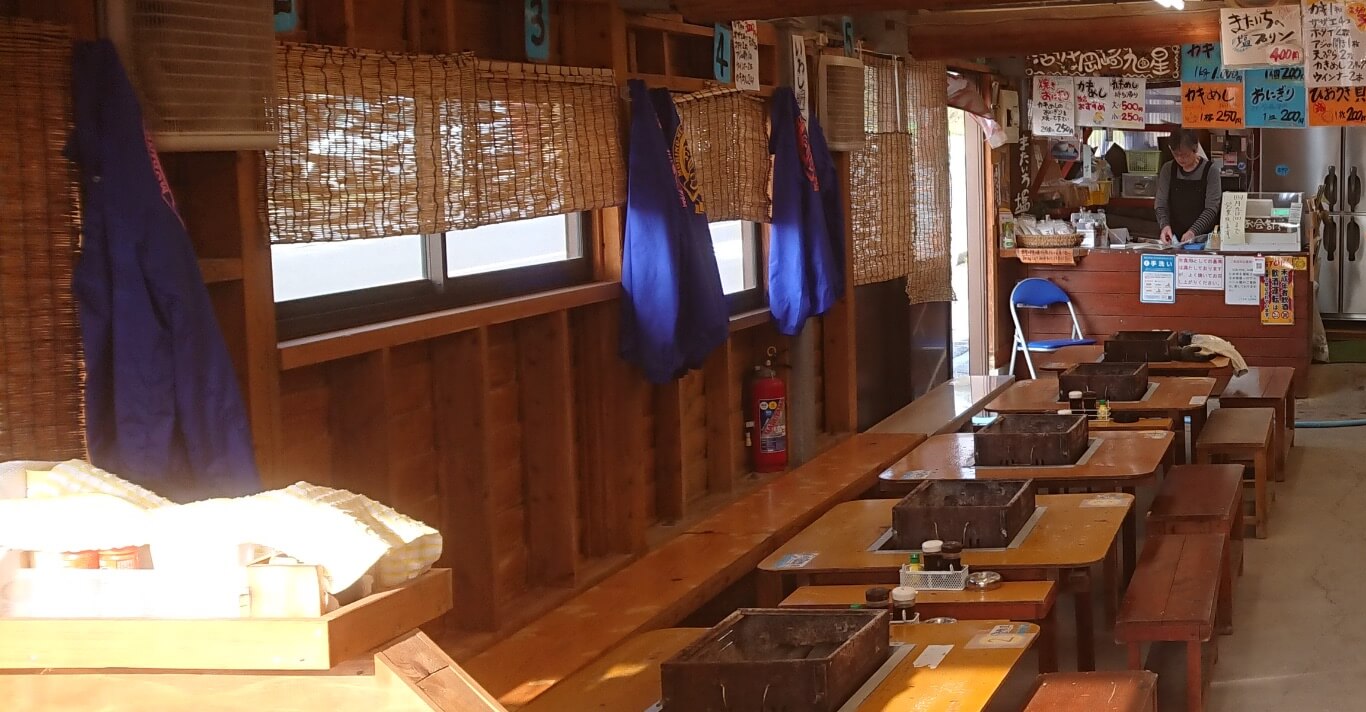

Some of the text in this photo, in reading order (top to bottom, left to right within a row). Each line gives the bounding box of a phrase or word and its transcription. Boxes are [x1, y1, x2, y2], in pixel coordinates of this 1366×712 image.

[716, 32, 728, 77] 4
[1185, 87, 1234, 104] カキめし
[1251, 85, 1295, 104] おにぎり
